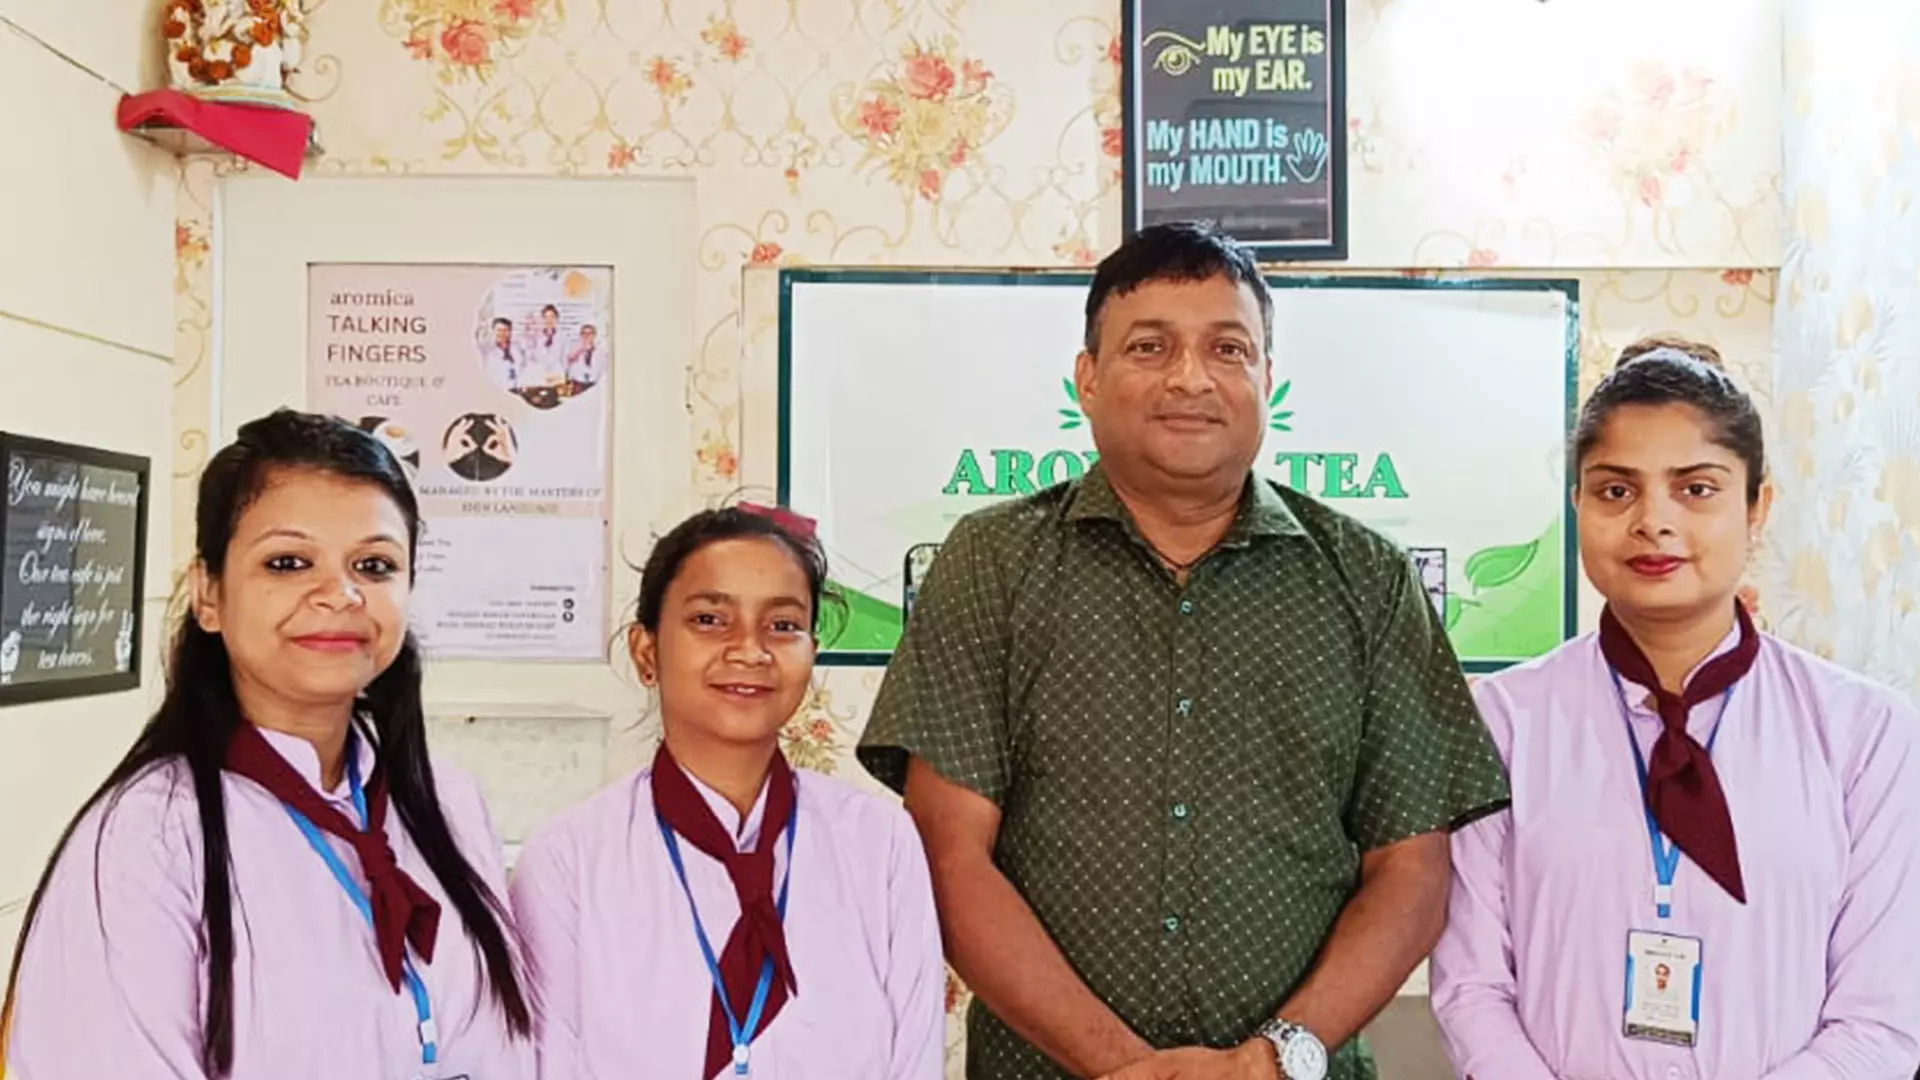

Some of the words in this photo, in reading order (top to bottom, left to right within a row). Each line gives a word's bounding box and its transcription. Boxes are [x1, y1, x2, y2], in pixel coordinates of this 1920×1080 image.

[1207, 25, 1245, 62] My
[1249, 25, 1297, 55] EYE
[1301, 25, 1325, 54] is
[1212, 66, 1251, 97] my
[1255, 59, 1313, 90] EAR.
[1146, 119, 1184, 157] My
[1189, 119, 1260, 149] HAND
[1265, 118, 1289, 148] is
[1147, 160, 1184, 192] my
[1190, 153, 1288, 185] MOUTH.
[330, 288, 415, 306] aromica
[327, 314, 427, 335] TALKING
[326, 344, 427, 364] FINGERS
[942, 448, 1101, 496] ARO
[1274, 451, 1409, 499] TEA
